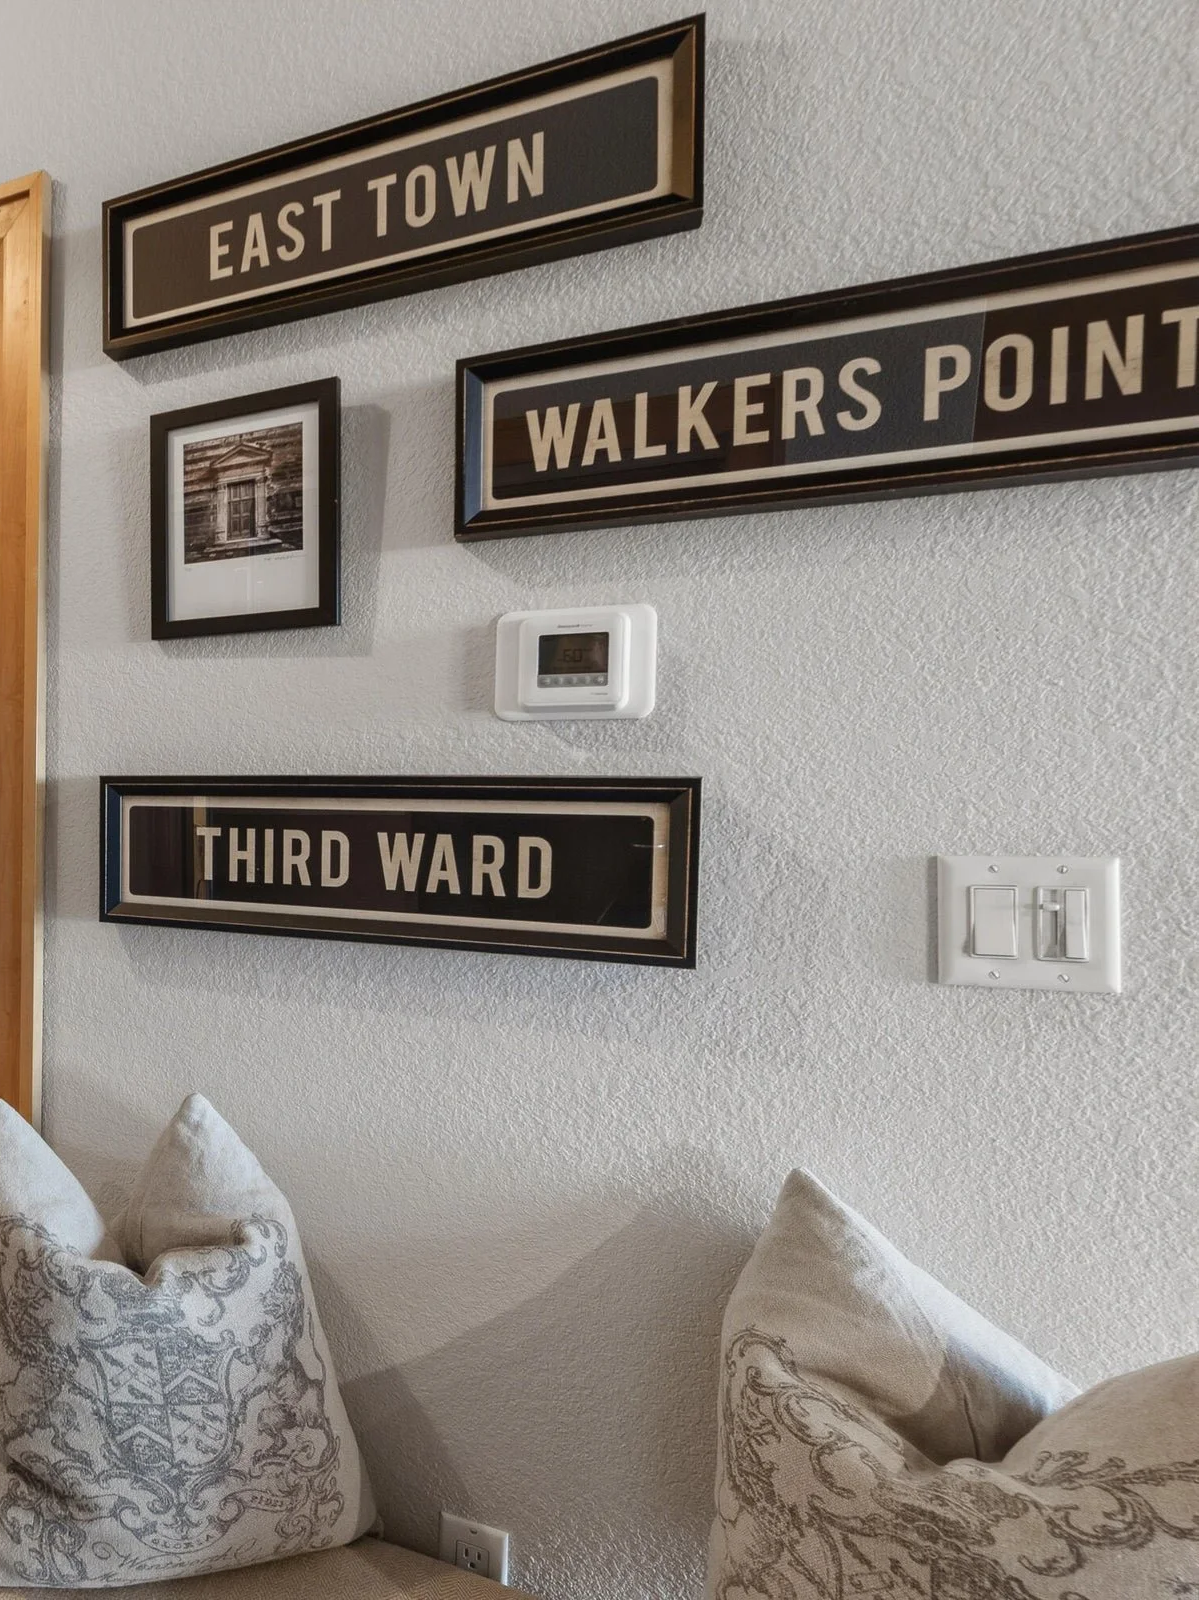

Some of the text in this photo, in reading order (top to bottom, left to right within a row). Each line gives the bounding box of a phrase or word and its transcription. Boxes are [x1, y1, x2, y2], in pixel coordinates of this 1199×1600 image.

[208, 131, 545, 281] EAST TOWN
[525, 305, 1199, 473] WALKERS POINT
[196, 826, 553, 900] THIRD WARD
